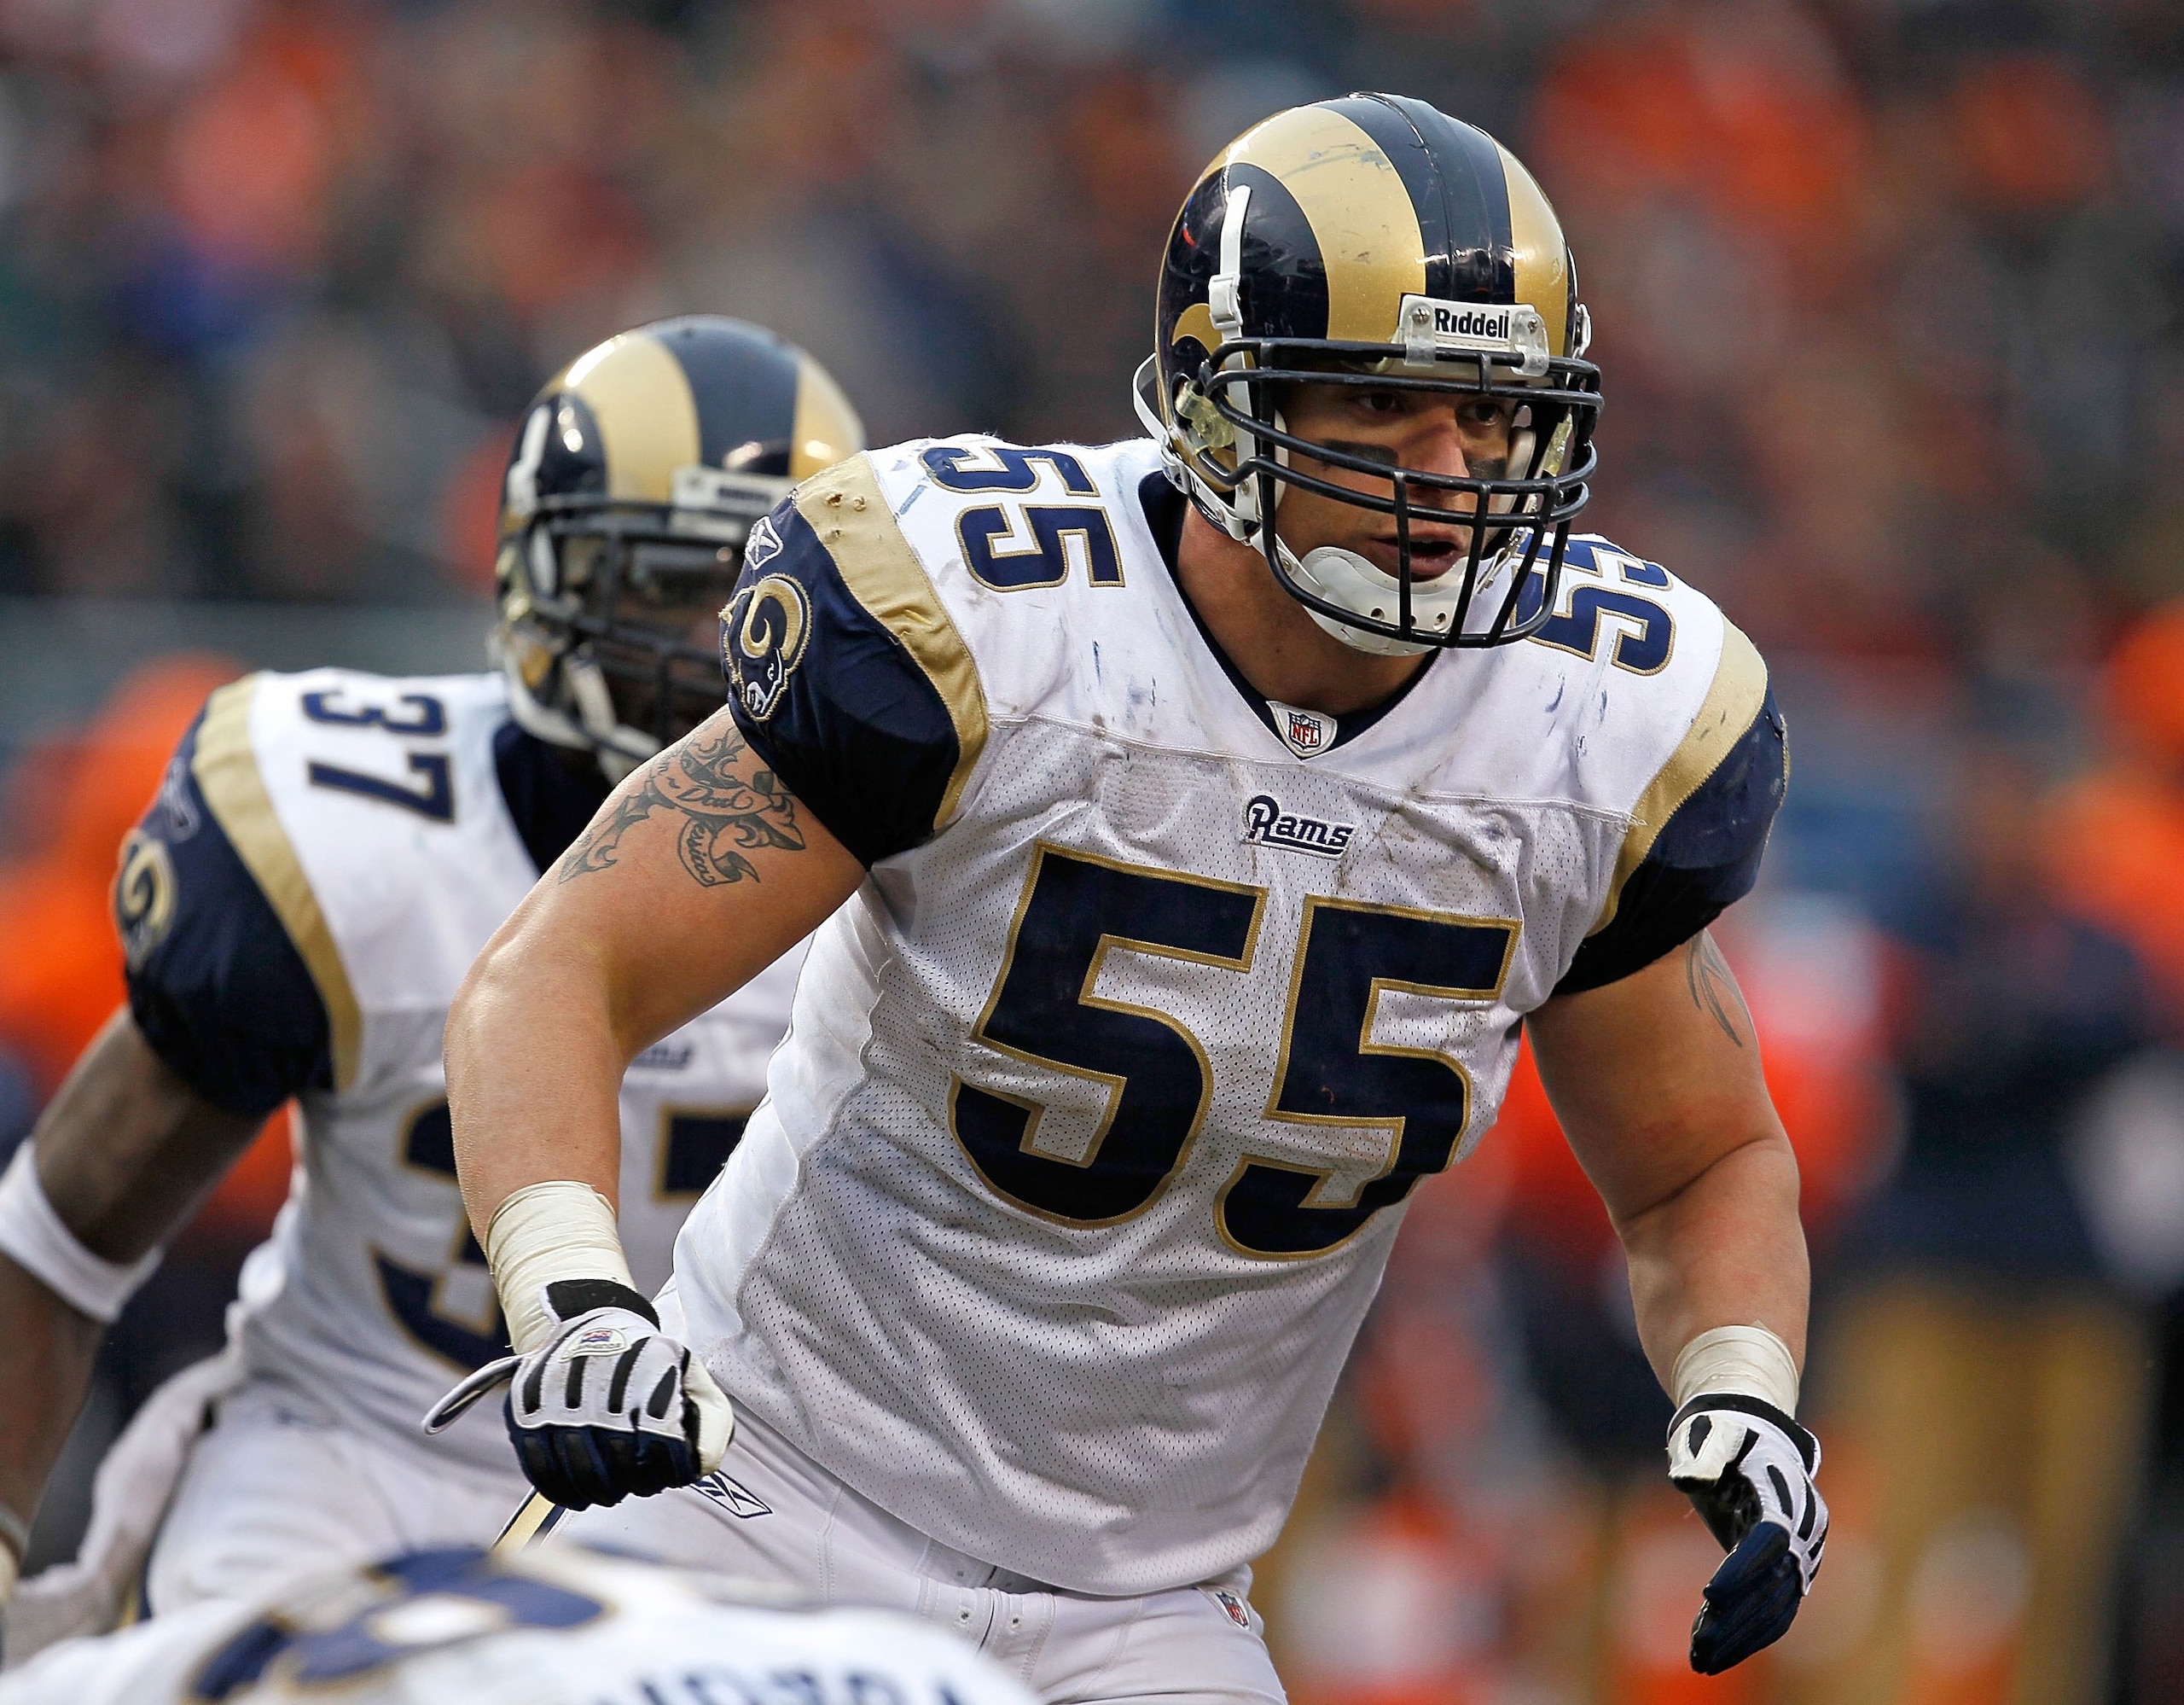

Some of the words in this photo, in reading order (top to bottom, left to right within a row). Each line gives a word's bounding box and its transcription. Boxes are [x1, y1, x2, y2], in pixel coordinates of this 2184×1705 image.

[1435, 308, 1509, 340] Riddell
[918, 446, 1126, 592] 55
[299, 690, 457, 825] 37
[1291, 723, 1318, 745] NFL
[1246, 794, 1354, 854] Rams
[947, 840, 1522, 1262] 55
